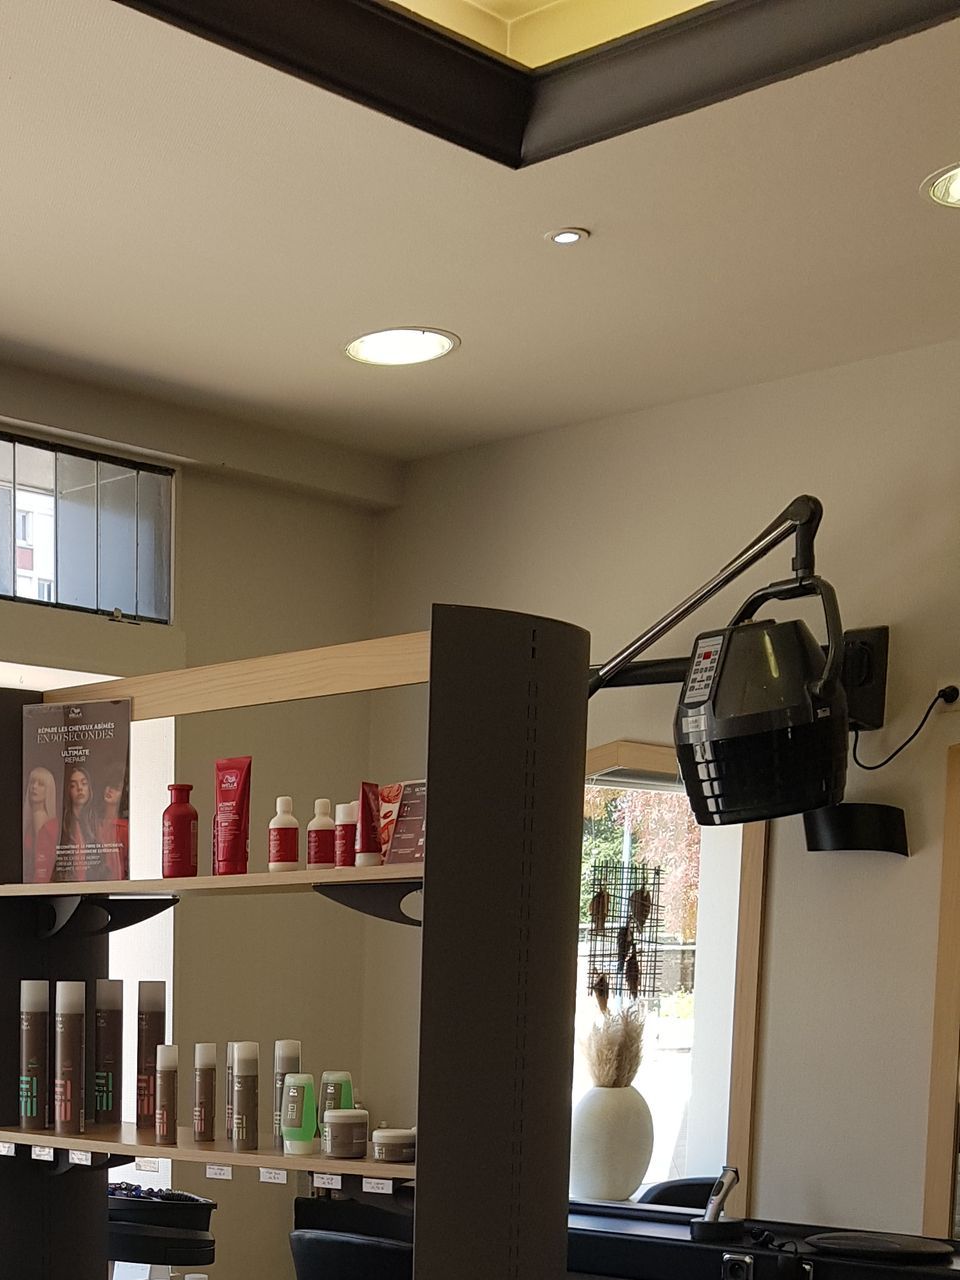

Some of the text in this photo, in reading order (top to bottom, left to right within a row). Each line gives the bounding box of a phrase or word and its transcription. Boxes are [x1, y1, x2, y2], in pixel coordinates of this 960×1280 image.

[69, 724, 93, 732] CHEVEUX
[38, 730, 114, 744] EN 90 SECONDES
[61, 749, 90, 757] ULTIMATE
